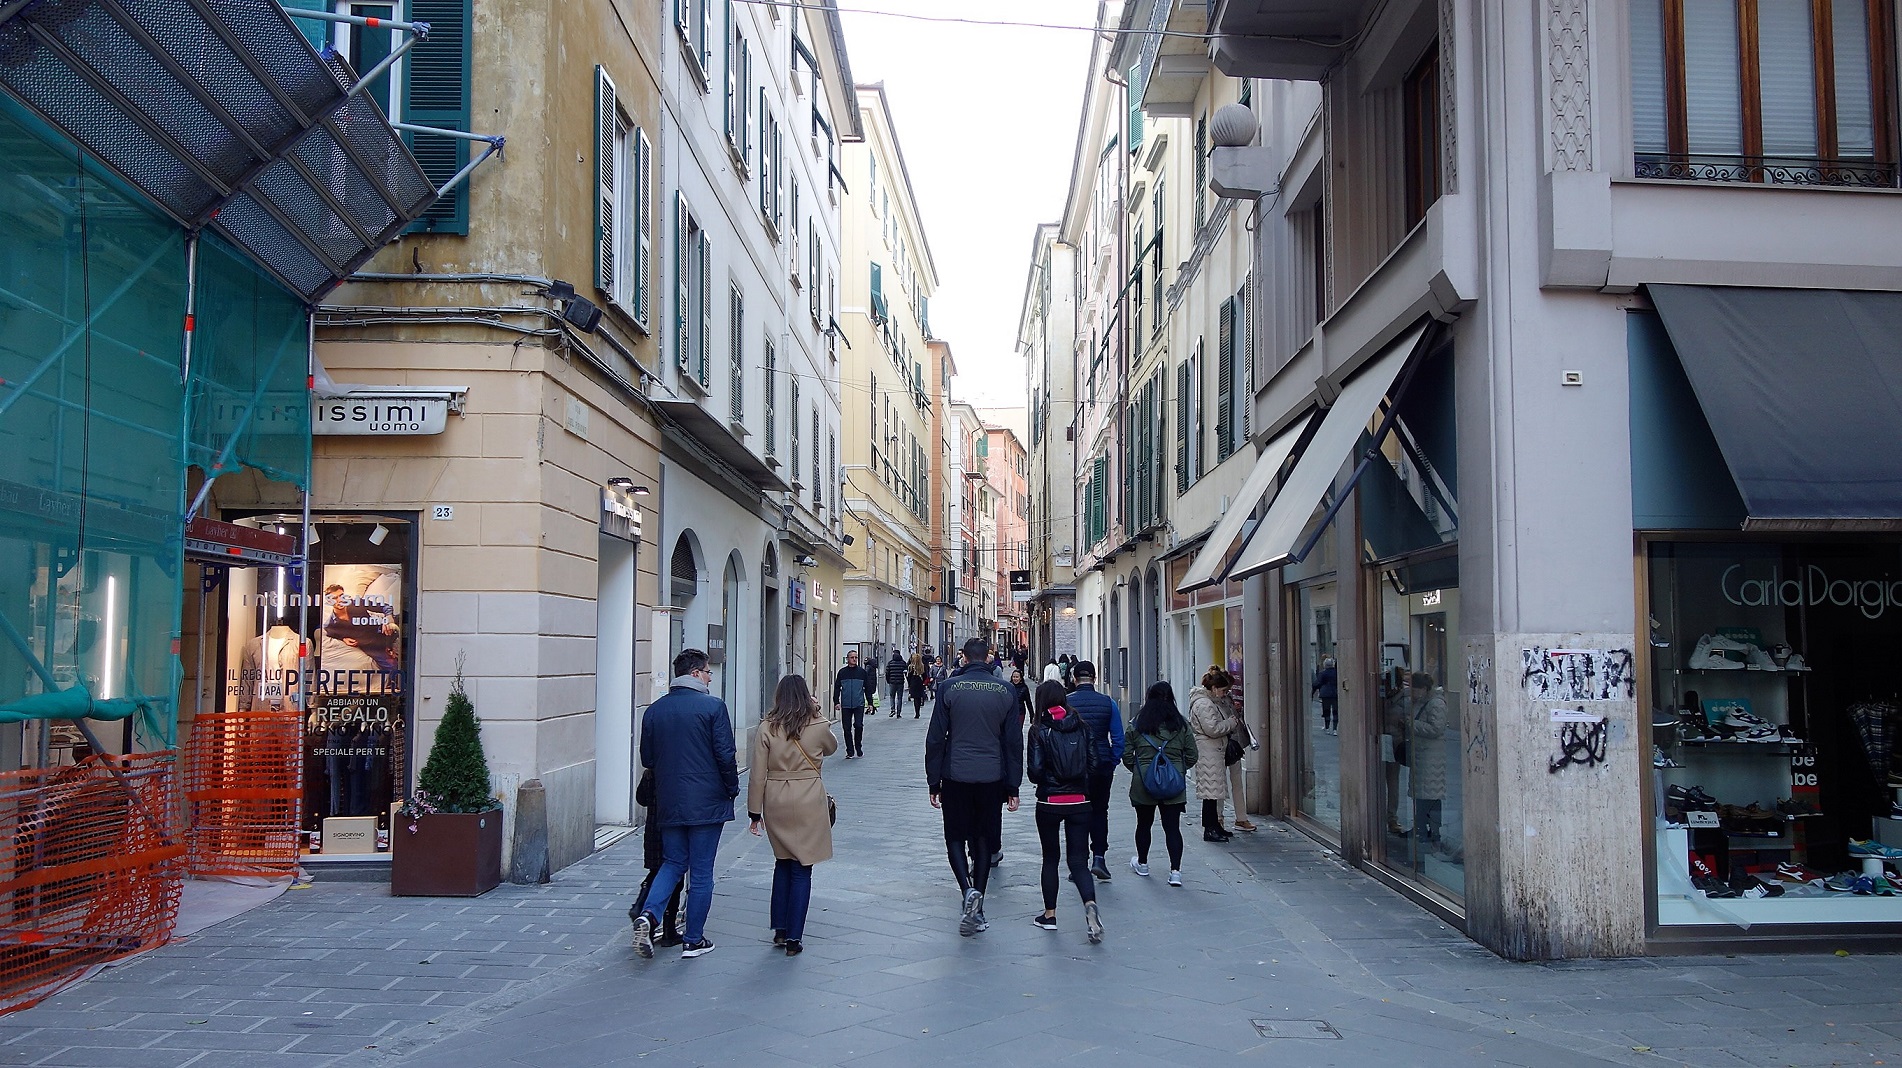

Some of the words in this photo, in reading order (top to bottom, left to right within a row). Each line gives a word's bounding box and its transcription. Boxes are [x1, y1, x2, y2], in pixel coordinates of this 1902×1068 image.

[369, 422, 420, 432] uomo
[436, 507, 450, 518] 23
[1721, 564, 1803, 607] Carla
[352, 616, 390, 626] uomo
[228, 669, 237, 681] IL
[242, 669, 282, 681] REGALO
[285, 669, 407, 697] PERFETTO
[227, 685, 245, 696] PER
[248, 685, 256, 696] IL
[260, 683, 282, 696] PAPÀ
[317, 707, 388, 722] REGALO
[313, 748, 354, 756] SPECIALE
[356, 748, 373, 756] PER
[375, 747, 385, 756] TE
[1694, 860, 1712, 875] 40%
